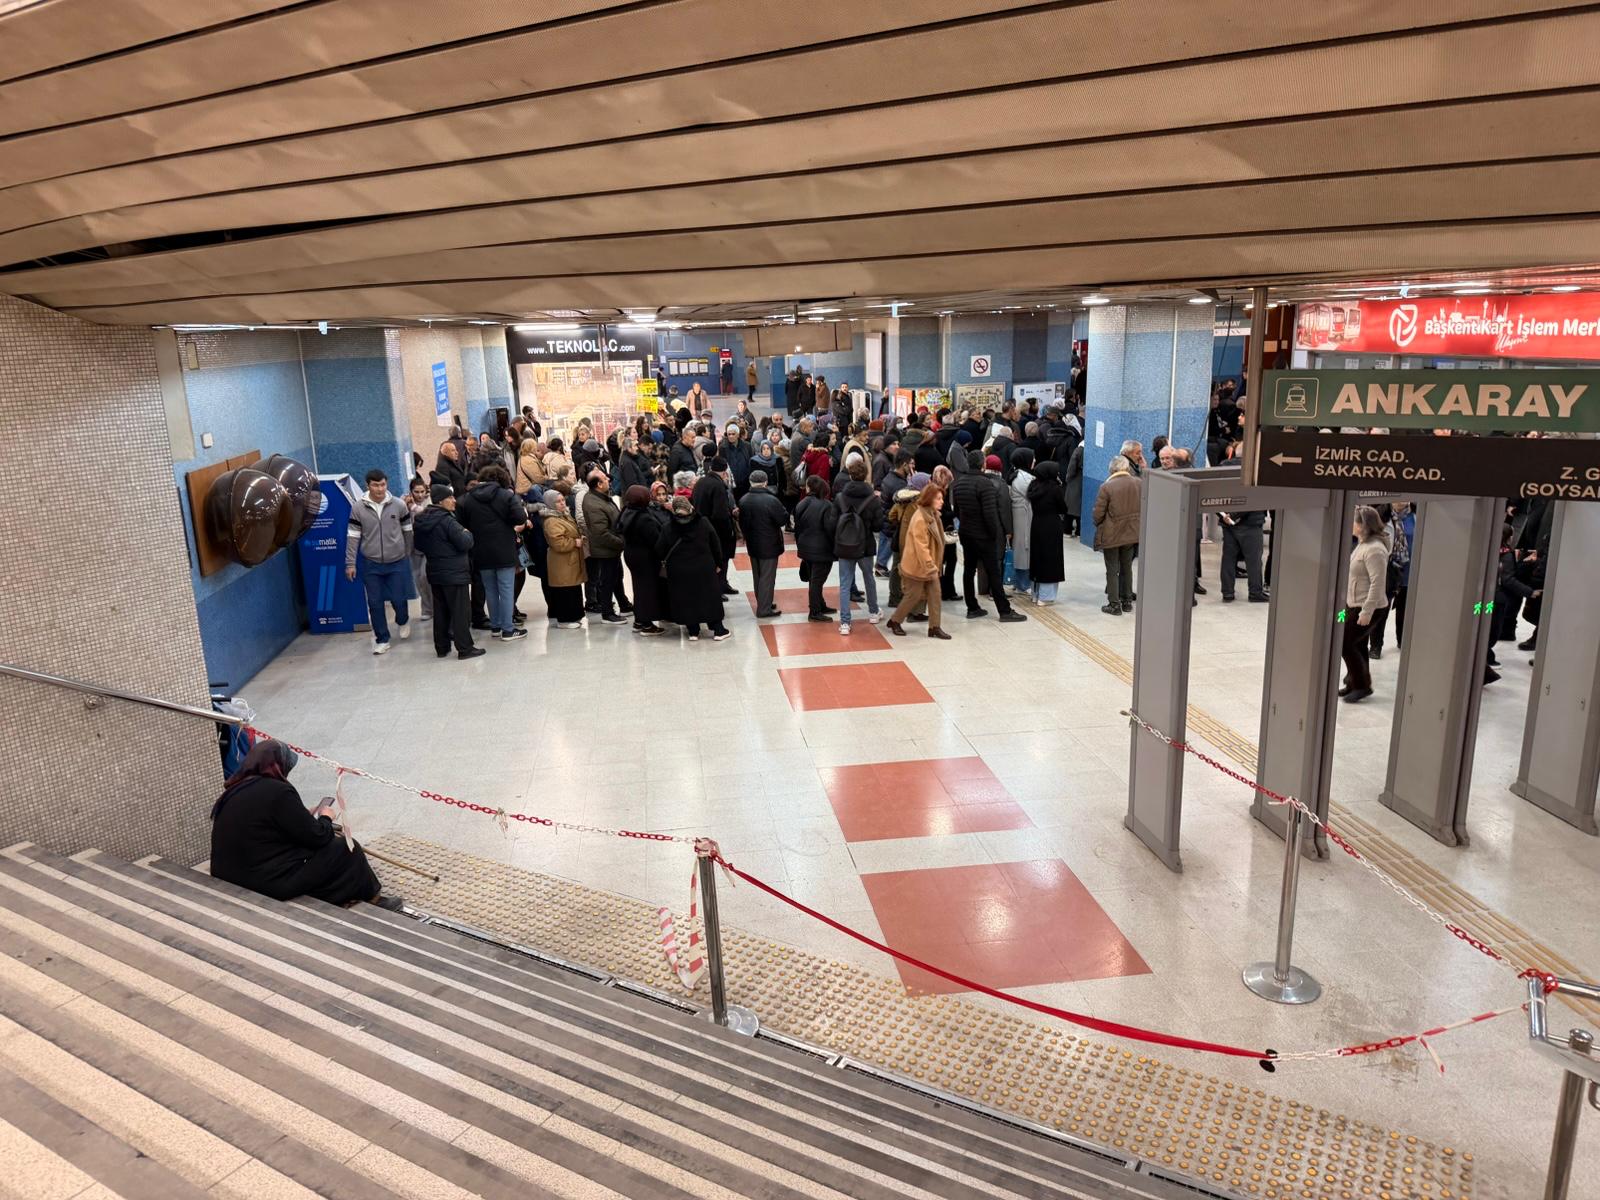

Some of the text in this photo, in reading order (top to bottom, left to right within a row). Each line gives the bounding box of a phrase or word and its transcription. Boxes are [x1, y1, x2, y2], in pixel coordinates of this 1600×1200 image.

[1517, 313, 1558, 338] İşlem
[1330, 383, 1588, 418] ANKARAY
[1315, 444, 1409, 463] İZMİR CAD.
[1314, 463, 1446, 482] SAKARYA CAD.
[1560, 466, 1578, 480] Z.
[1519, 482, 1600, 498] (SOYSA
[1201, 497, 1232, 506] GARRETT
